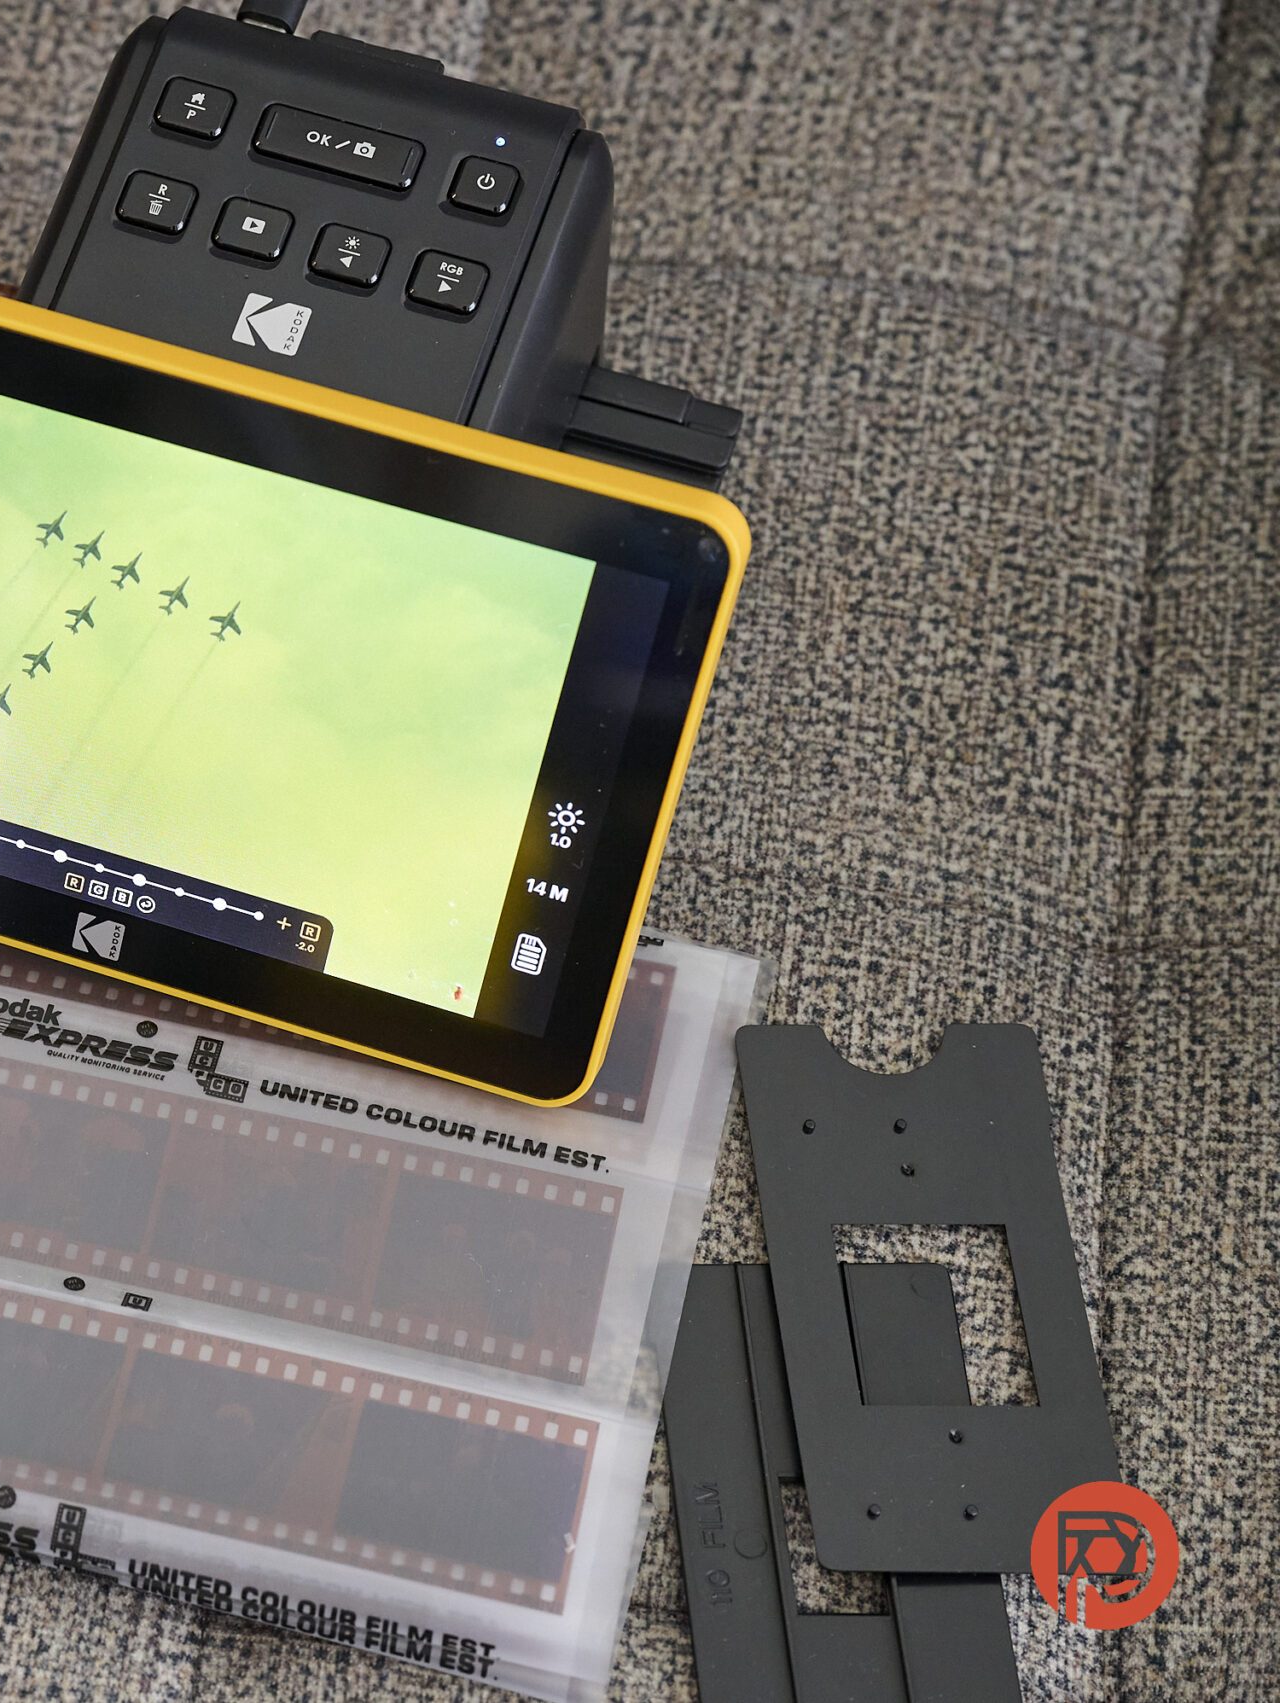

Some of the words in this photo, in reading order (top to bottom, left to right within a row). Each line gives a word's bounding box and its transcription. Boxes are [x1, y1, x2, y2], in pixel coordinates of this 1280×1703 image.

[185, 109, 198, 120] P
[157, 184, 168, 195] R
[439, 261, 464, 277] RGB
[283, 309, 305, 352] KODAK
[549, 832, 571, 849] 1.0
[526, 878, 547, 897] 14
[549, 885, 569, 903] M
[108, 924, 122, 959] KODAK
[0, 1021, 180, 1072] EXPRESS
[46, 1048, 80, 1063] QUALITY
[80, 1055, 131, 1075] MONITORING
[132, 1067, 166, 1081] SERVICE
[259, 1079, 359, 1115] UNITED
[366, 1102, 476, 1142] COLOUR
[482, 1130, 548, 1160] FILM
[553, 1145, 610, 1174] EST.
[694, 1481, 726, 1548] FILM
[128, 1559, 232, 1599] UNITED
[240, 1586, 357, 1626] COLOUR
[365, 1616, 434, 1645] FILM
